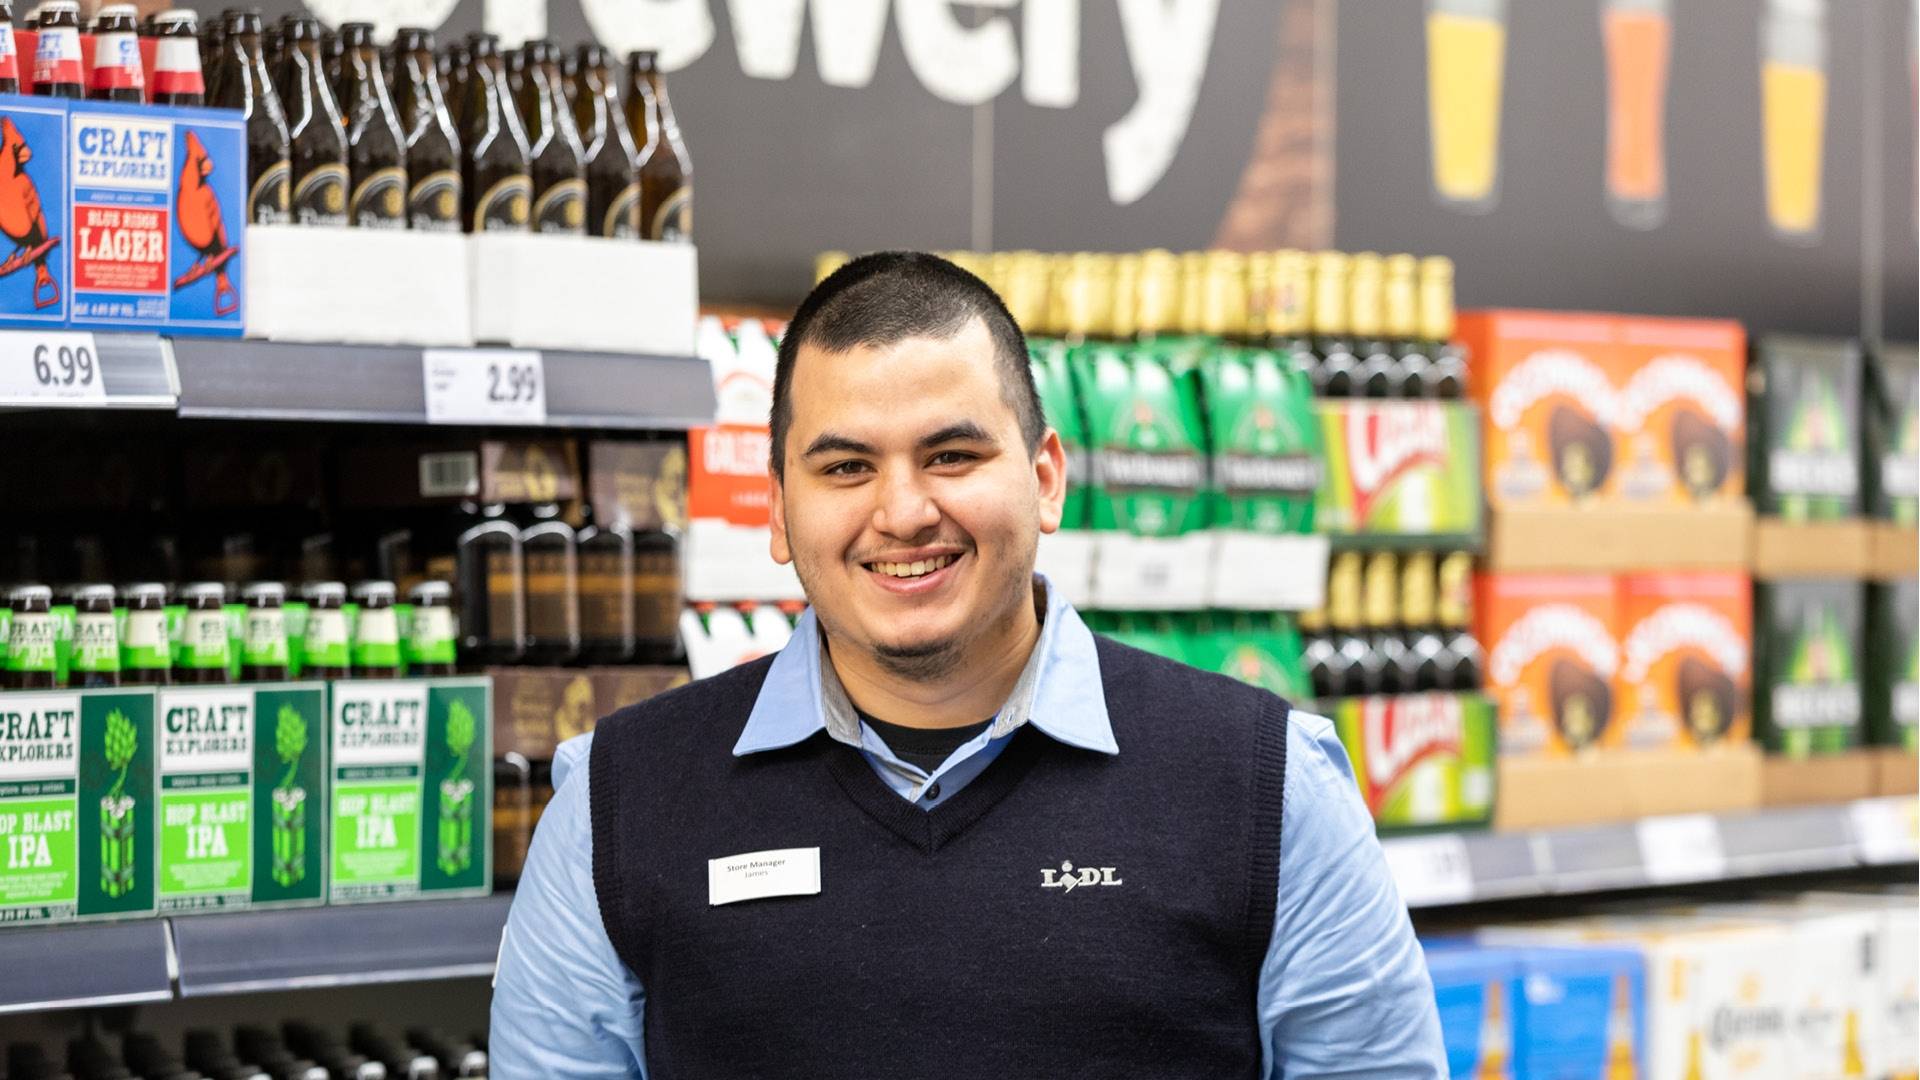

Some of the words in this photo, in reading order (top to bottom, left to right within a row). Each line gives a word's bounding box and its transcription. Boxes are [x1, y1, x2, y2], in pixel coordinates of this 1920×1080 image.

[306, 0, 1221, 205] wery
[78, 127, 167, 159] CRAFT
[78, 159, 165, 179] EXPLORERS
[79, 227, 164, 262] LAGER
[33, 344, 93, 386] 6.99
[488, 363, 536, 402] 2.99
[166, 706, 247, 733] CRAFT
[341, 701, 419, 726] CRAFT
[0, 744, 73, 762] XPLORERS
[0, 814, 17, 834] OP
[23, 810, 72, 833] BLAST
[355, 816, 398, 849] IPA
[8, 834, 53, 869] IPA
[187, 825, 229, 859] IPA
[727, 864, 748, 872] Store
[750, 860, 786, 868] Manager
[745, 870, 769, 878] James
